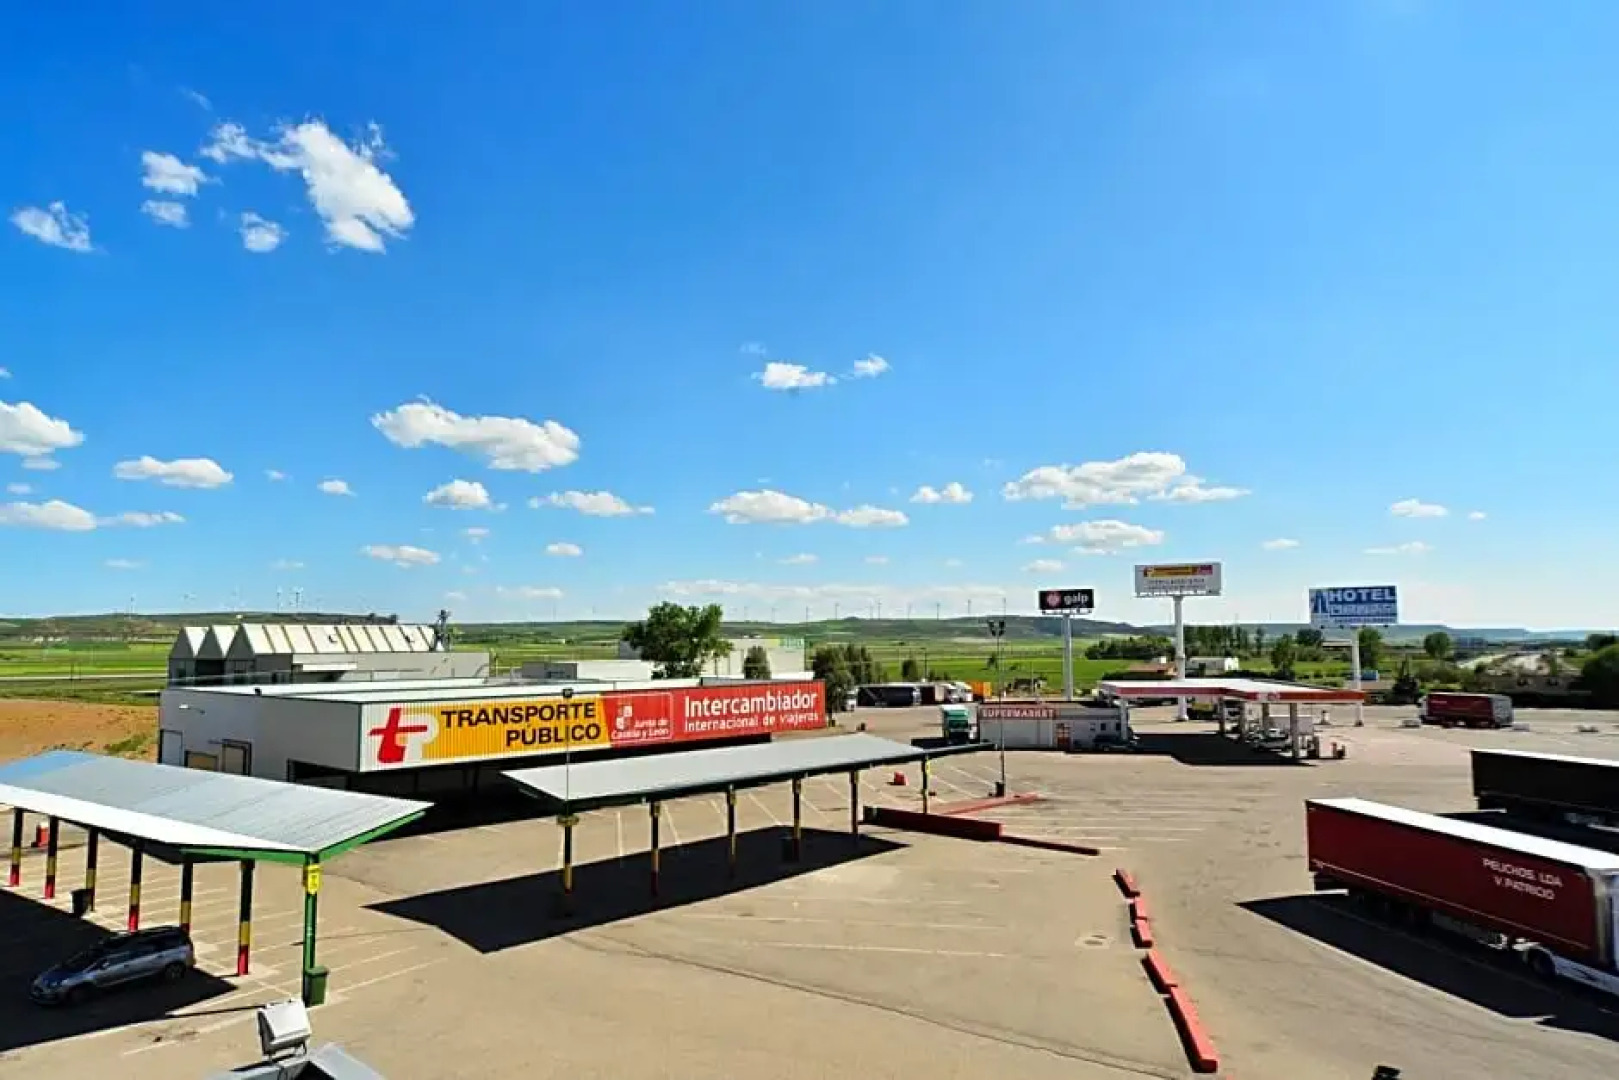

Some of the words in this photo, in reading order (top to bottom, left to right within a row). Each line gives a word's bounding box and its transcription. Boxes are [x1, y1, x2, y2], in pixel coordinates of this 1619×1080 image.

[1064, 592, 1089, 605] galp
[1329, 588, 1394, 602] HOTEL
[684, 689, 818, 718] Intercambiador
[983, 708, 1054, 718] SUPERMARKET
[441, 702, 596, 728] TRANSPORTE
[685, 714, 759, 733] Internacional
[763, 712, 776, 727] de
[780, 711, 819, 727] viajeros
[506, 722, 601, 747] PÚBLICO
